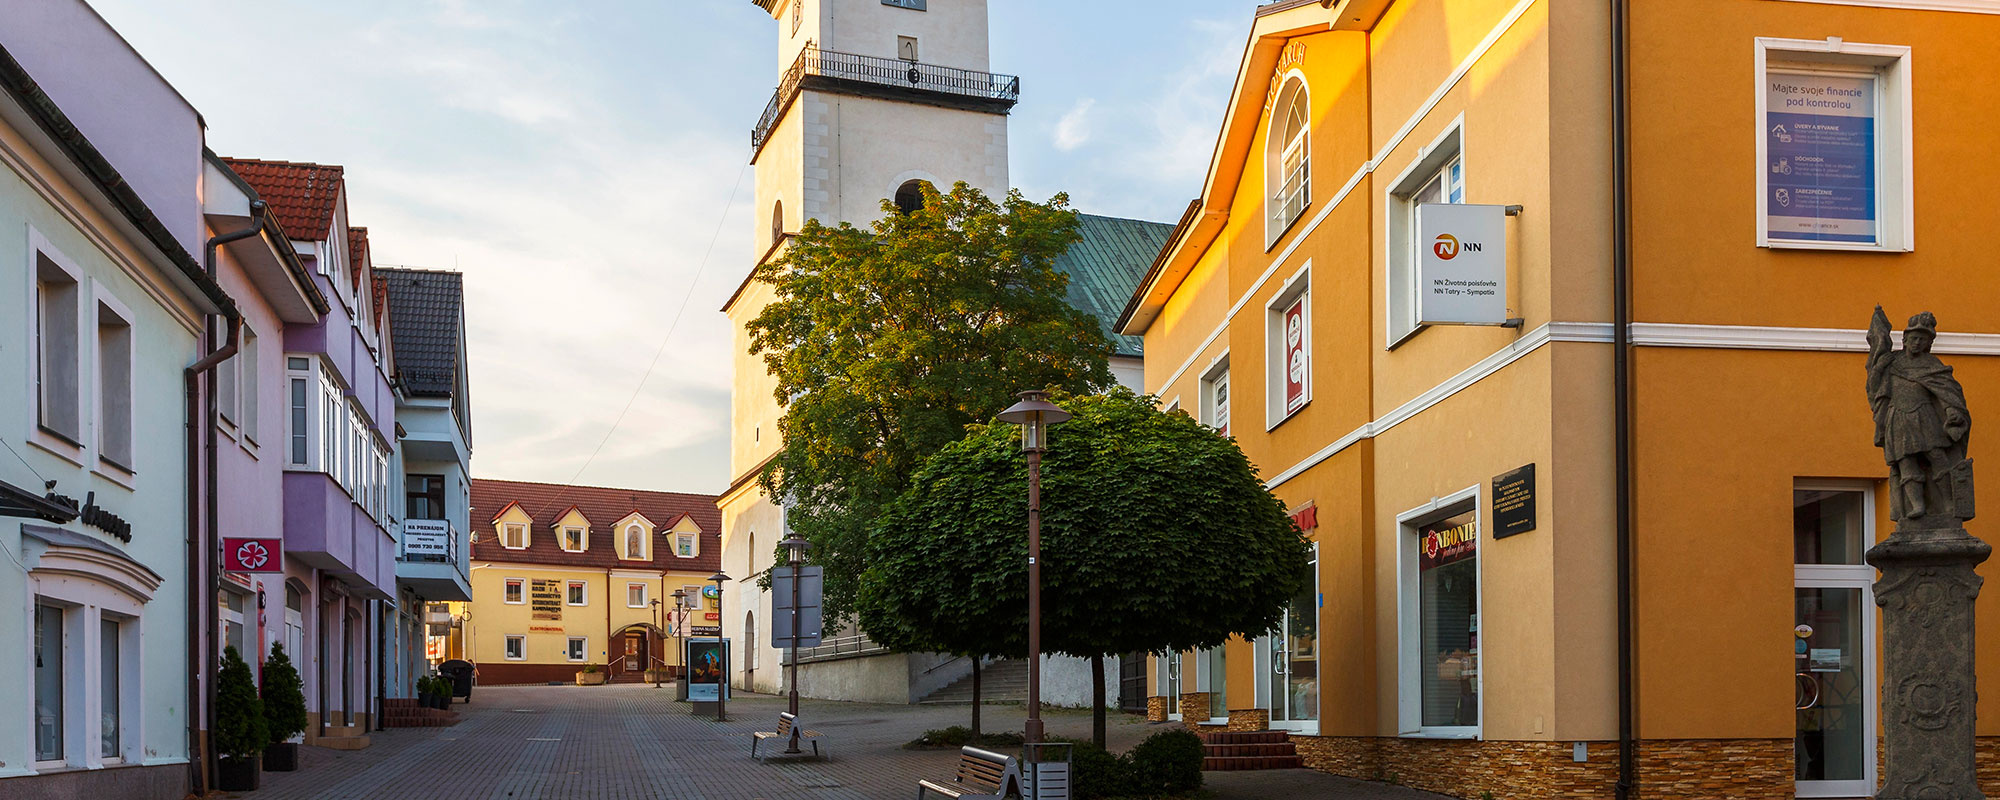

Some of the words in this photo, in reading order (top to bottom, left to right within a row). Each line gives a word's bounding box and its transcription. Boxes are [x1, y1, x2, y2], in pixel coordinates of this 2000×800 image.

[1264, 41, 1306, 117] MONARCH
[1772, 83, 1798, 94] Majte
[1800, 86, 1824, 96] svoje
[1826, 86, 1862, 97] financie
[1786, 98, 1803, 107] pod
[1806, 98, 1851, 109] kontrolou
[1463, 243, 1482, 252] NN
[1445, 288, 1460, 296] Tatry
[1421, 516, 1476, 556] BONBONIÉ
